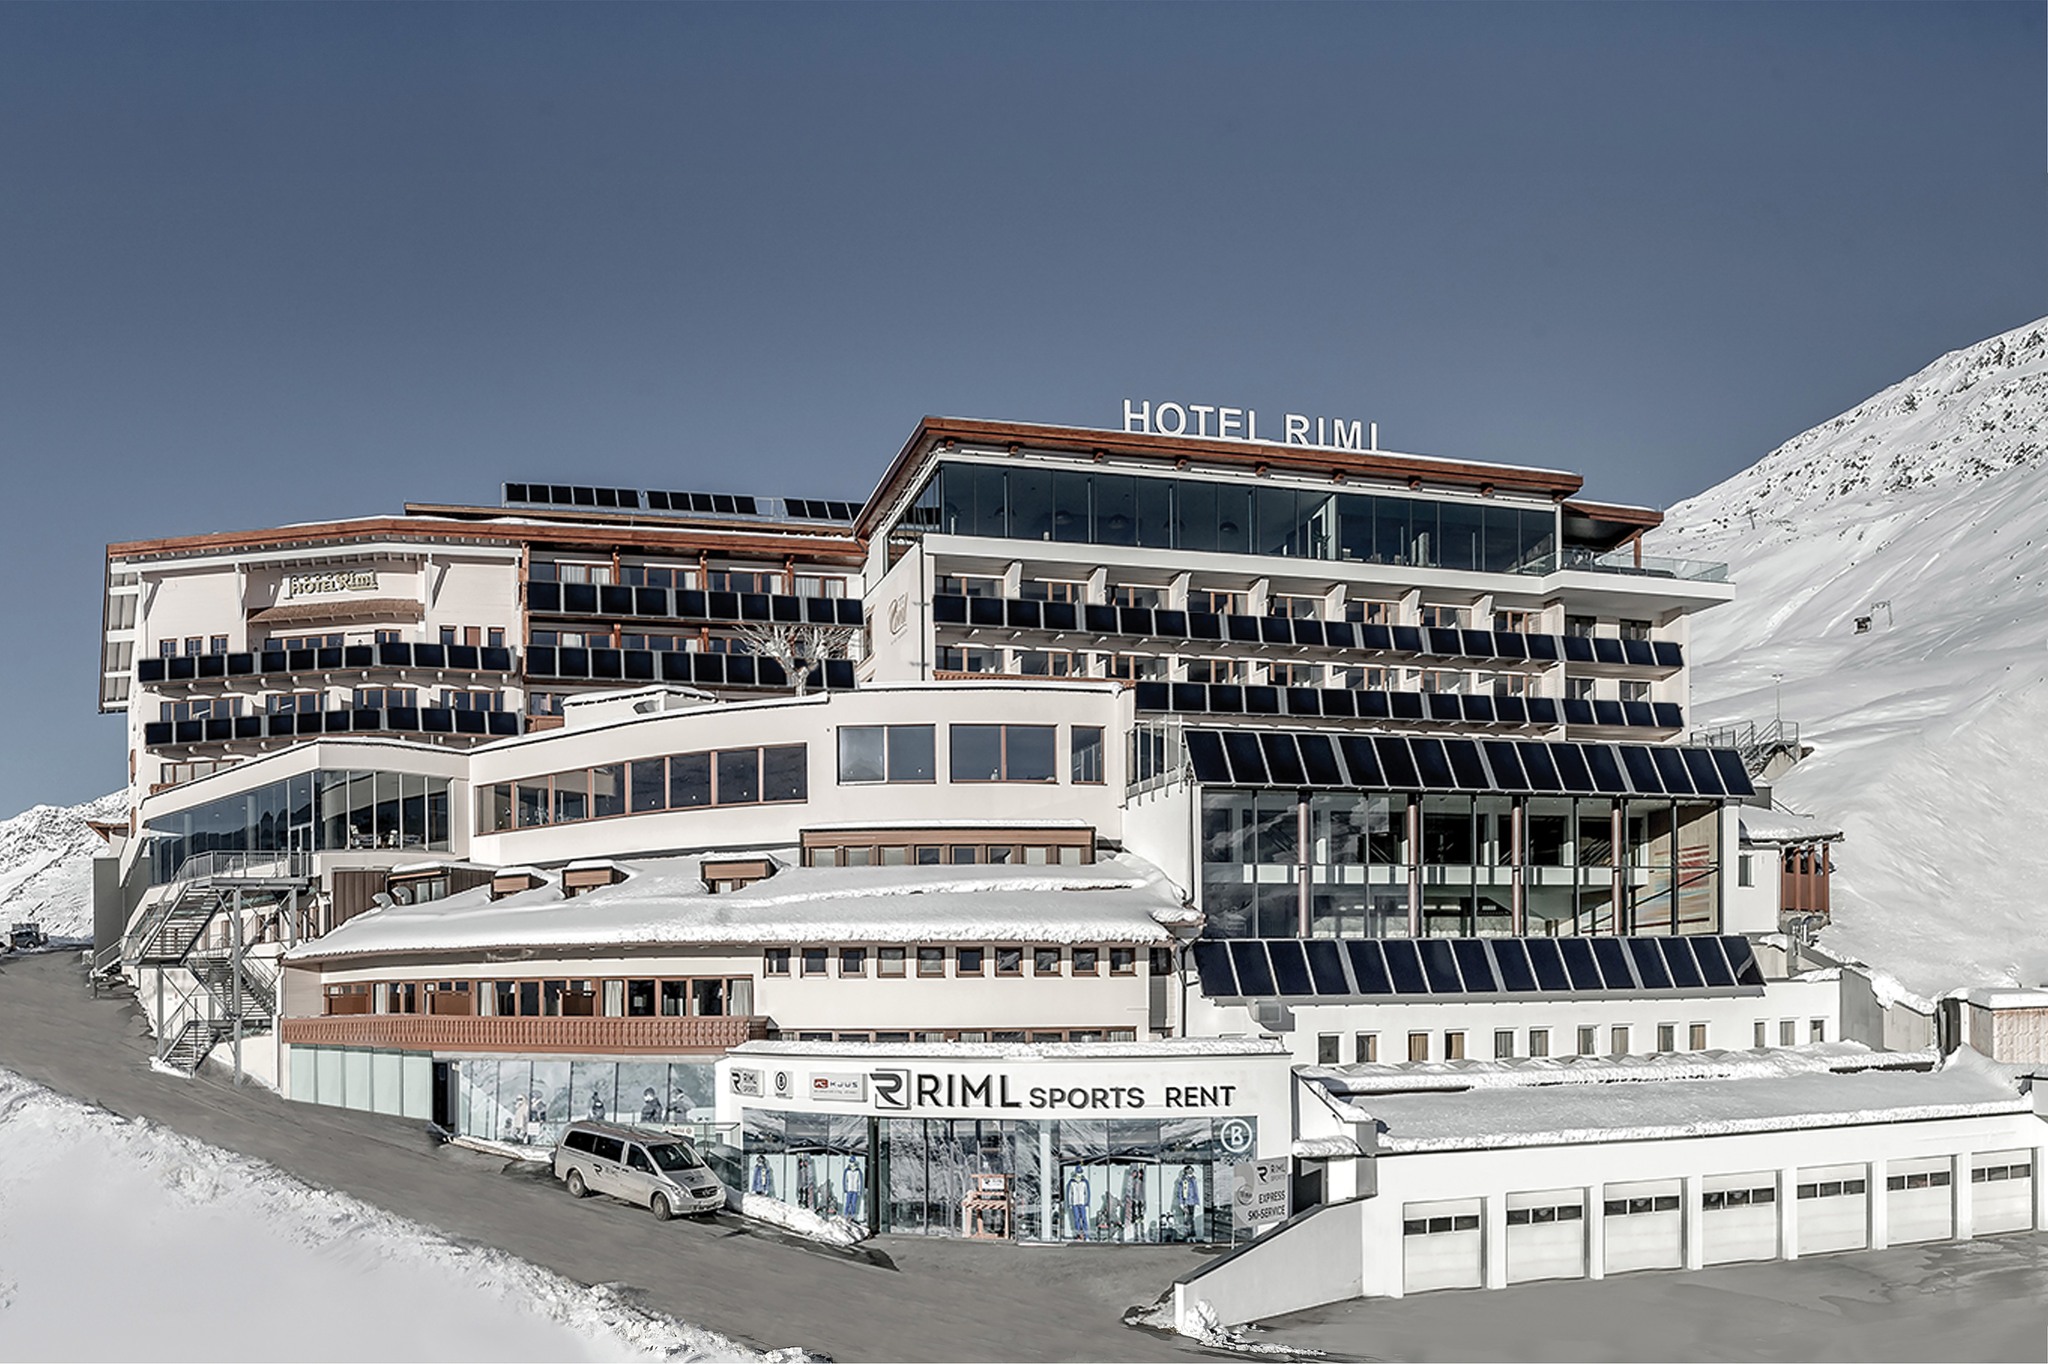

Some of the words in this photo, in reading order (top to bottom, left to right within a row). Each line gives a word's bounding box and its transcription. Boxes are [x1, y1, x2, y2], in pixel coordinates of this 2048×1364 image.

[1123, 399, 1269, 441] HOTEL
[917, 1073, 1022, 1108] RIML
[1029, 1086, 1145, 1109] SPORTS
[1165, 1086, 1236, 1108] RENT
[1258, 1190, 1286, 1204] EXPRESS
[1247, 1204, 1286, 1221] SKI-SERVICE
